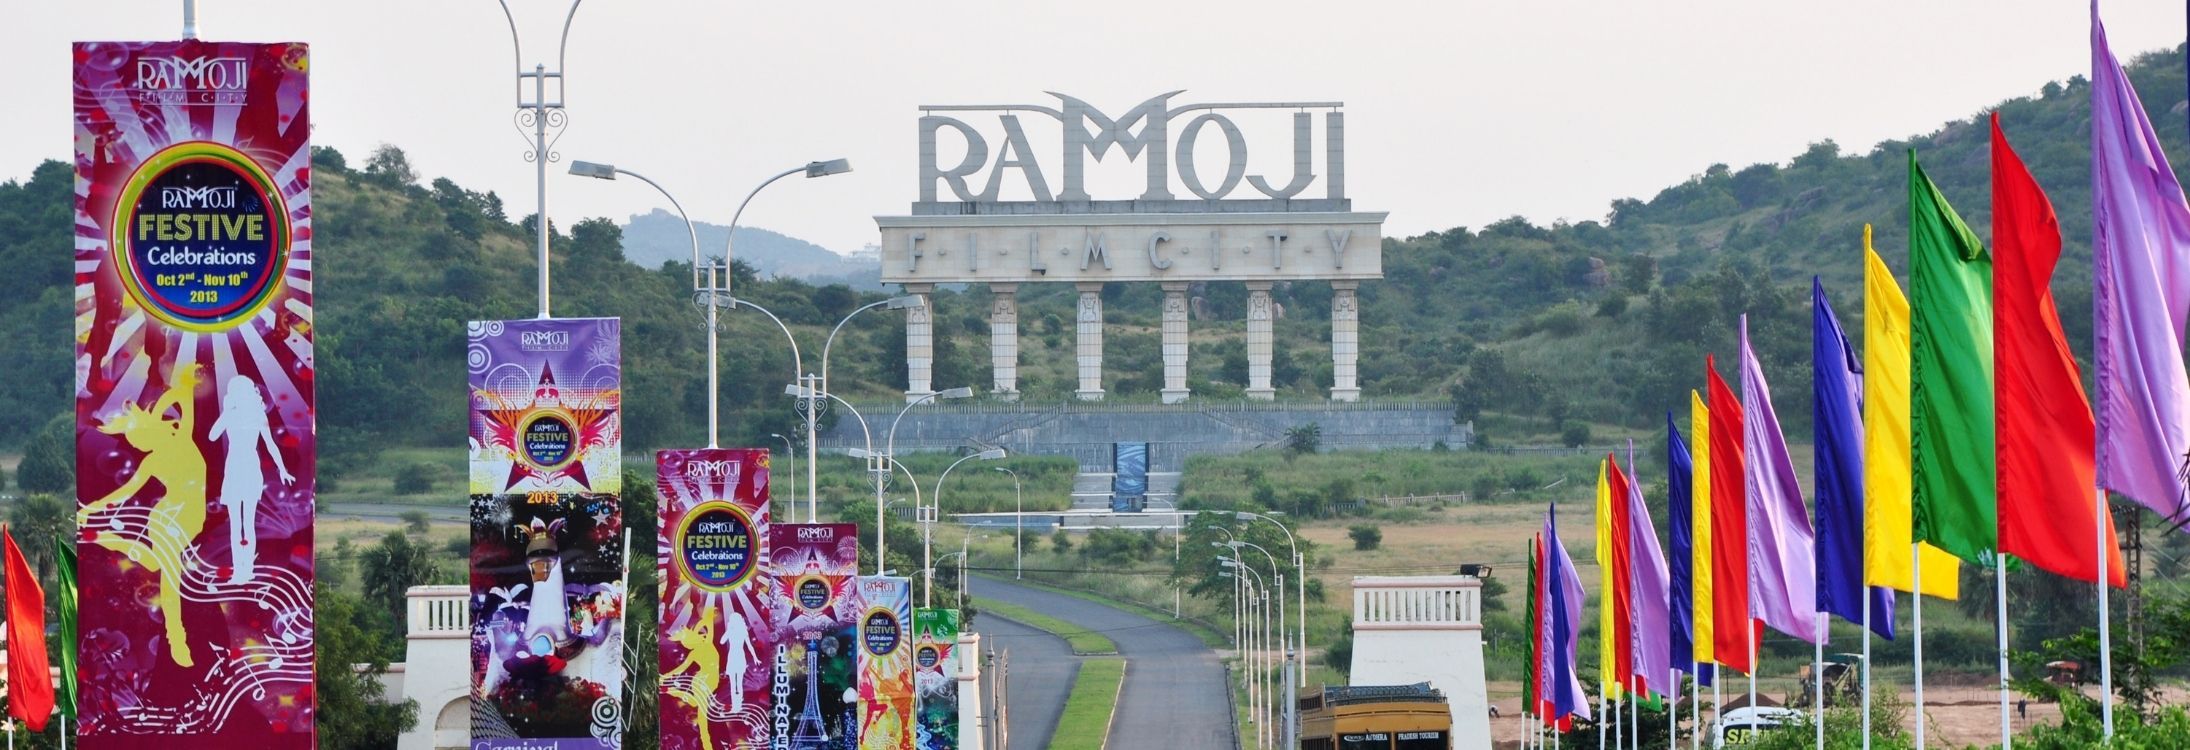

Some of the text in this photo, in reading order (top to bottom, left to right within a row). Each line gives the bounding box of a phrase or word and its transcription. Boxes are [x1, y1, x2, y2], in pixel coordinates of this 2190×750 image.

[137, 55, 247, 90] RAMOJI
[918, 89, 1344, 202] RAMOJI
[162, 186, 235, 209] RAMOJI
[139, 213, 264, 241] FESTIVE
[147, 246, 256, 266] Celebrations
[156, 274, 176, 287] Oct
[178, 272, 195, 286] 2nd
[204, 274, 226, 286] Nov
[228, 271, 249, 286] 10th
[190, 290, 219, 303] 2013
[521, 330, 569, 345] RAMOJI
[526, 432, 569, 442] FESTIVE
[529, 442, 566, 450] Celebrations
[687, 460, 740, 476] RAMOJI
[527, 491, 558, 504] 2013
[698, 522, 734, 533] RAMOJI
[797, 527, 834, 538] RAMOJI
[687, 535, 747, 549] FESTIVE
[691, 550, 744, 560] Celebrations
[865, 625, 896, 634] FESTIVE
